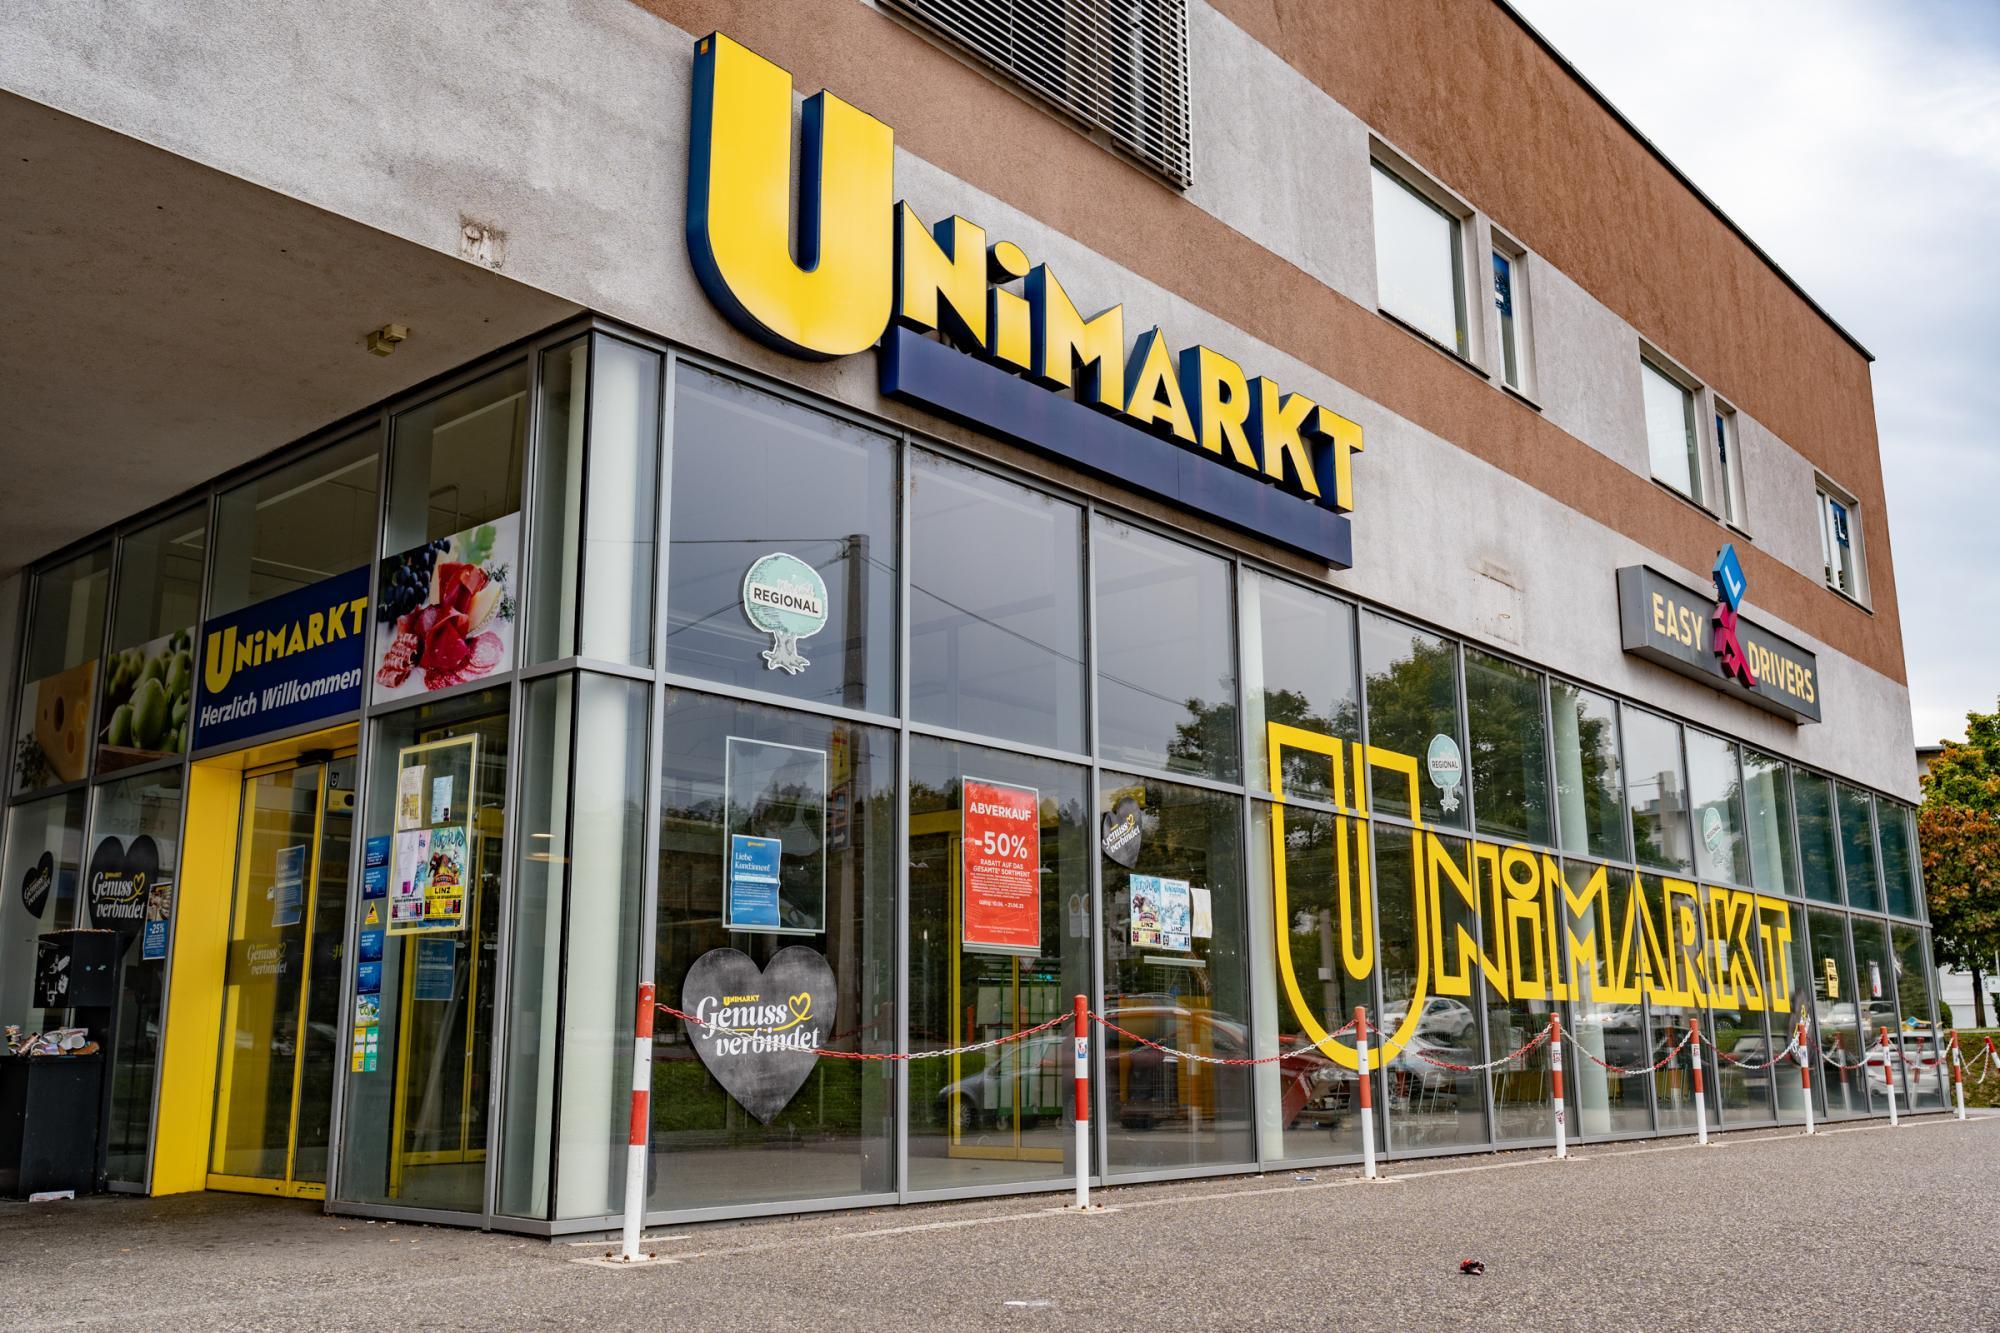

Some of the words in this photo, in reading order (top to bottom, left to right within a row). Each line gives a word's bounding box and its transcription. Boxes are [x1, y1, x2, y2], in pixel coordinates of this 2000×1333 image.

[753, 587, 819, 614] REGIONAL
[1652, 592, 1703, 652] EASY
[1747, 640, 1815, 704] DRIVERS
[199, 692, 258, 729] Herzlich
[261, 667, 362, 712] Willkommen
[1431, 760, 1459, 769] REGIONAL
[970, 802, 1032, 821] ABVERKAUF
[974, 831, 1028, 860] -50%
[980, 858, 1001, 867] RABATT
[1002, 861, 1013, 869] AUF
[1001, 869, 1031, 878] SORTIMENT
[92, 871, 133, 904] Genuss
[434, 887, 451, 895] LINZ
[96, 898, 146, 919] verbindet
[247, 943, 278, 966] Genuss
[251, 960, 288, 976] verbindet
[696, 996, 788, 1040] Genuss
[715, 1024, 821, 1057] verbindet
